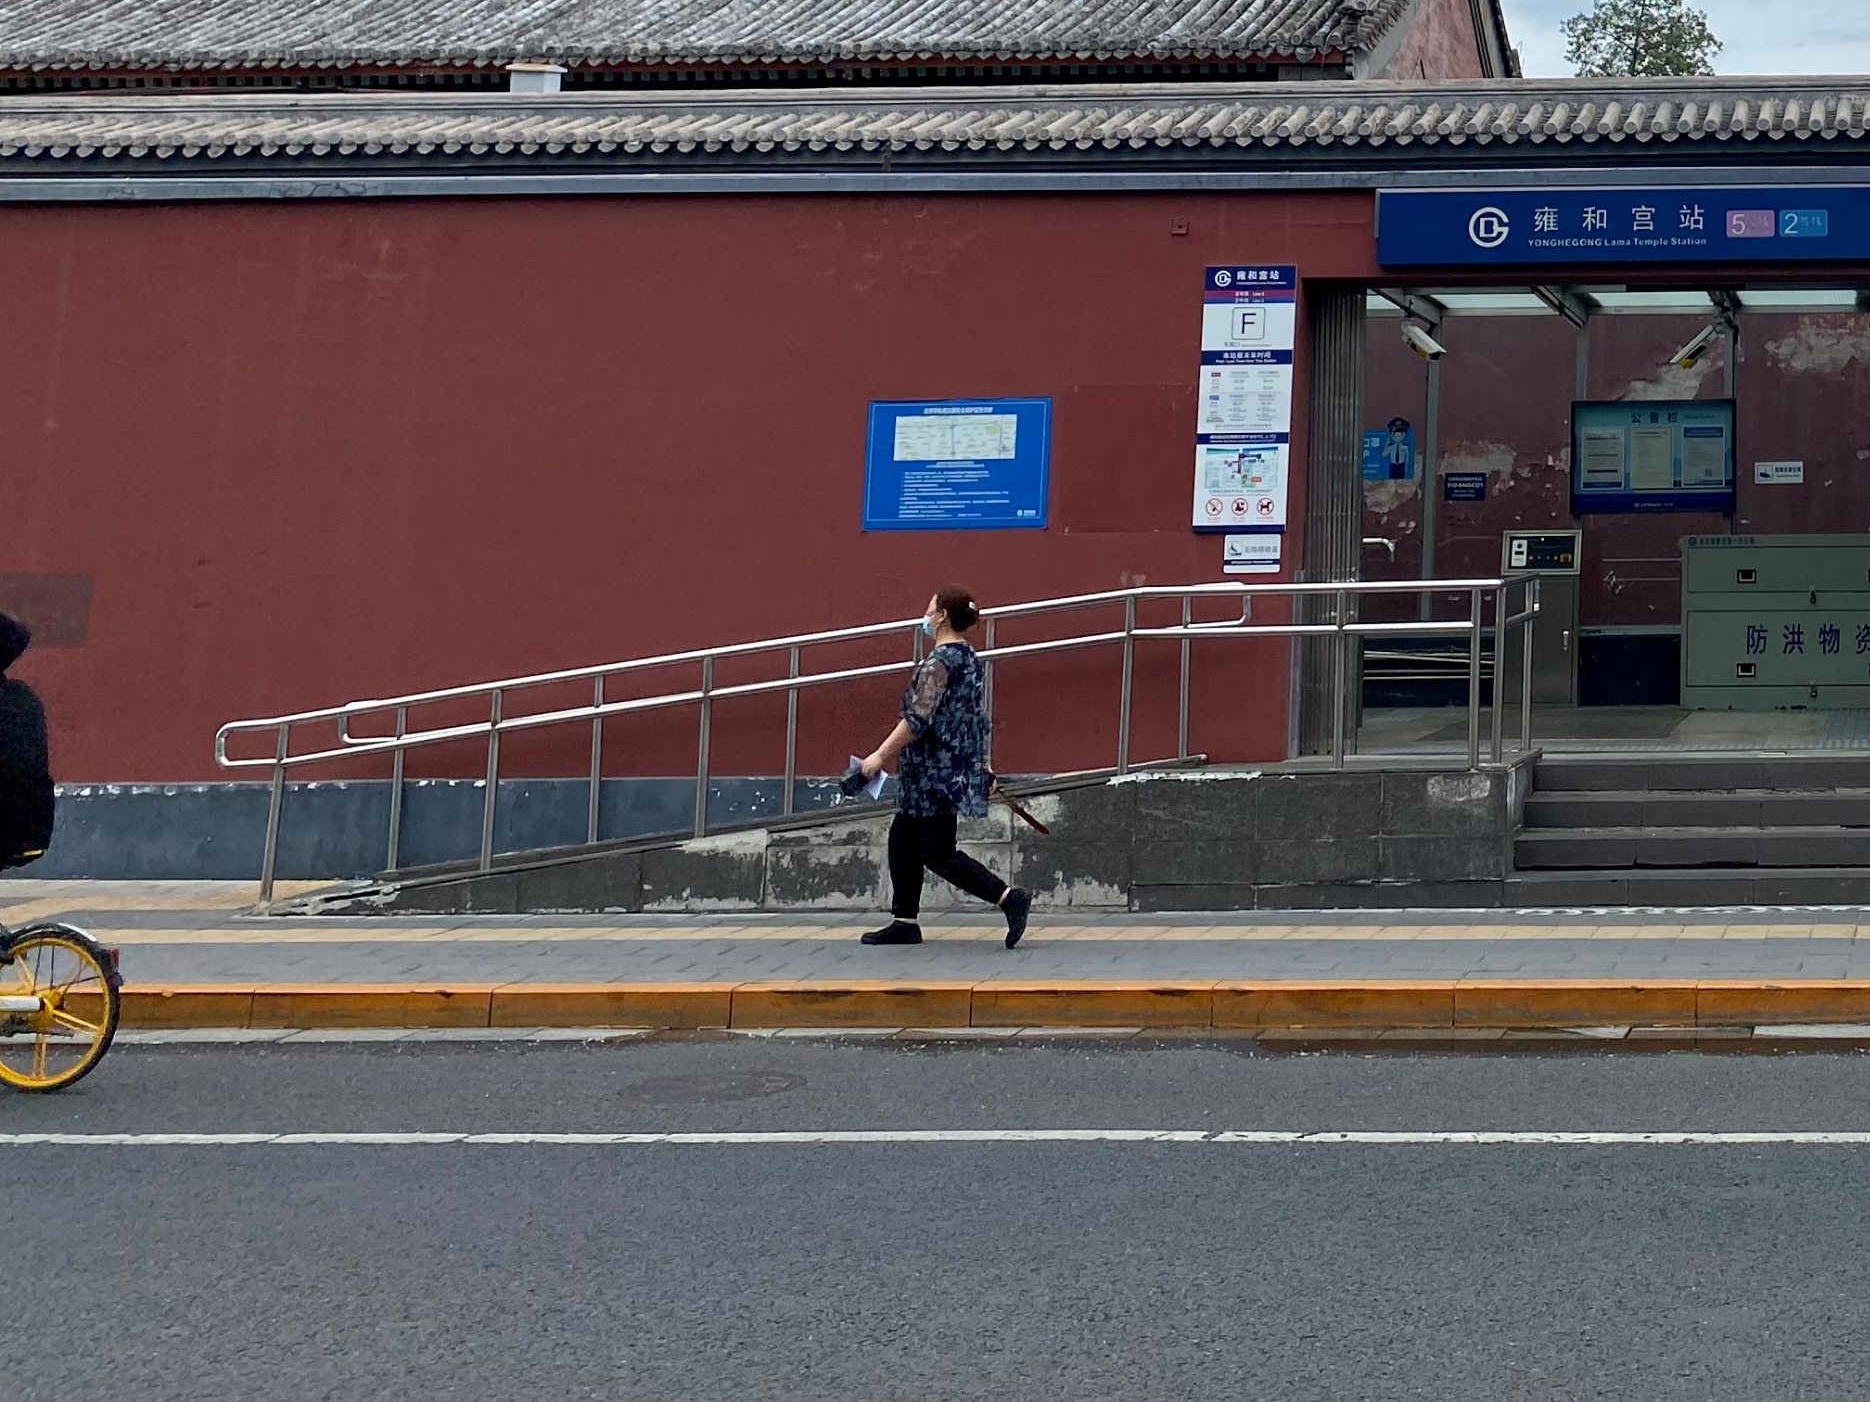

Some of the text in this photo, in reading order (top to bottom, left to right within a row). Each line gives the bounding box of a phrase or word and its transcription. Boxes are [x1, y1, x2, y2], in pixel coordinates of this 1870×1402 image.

[1534, 204, 1705, 233] 雍和宫站
[1528, 236, 1707, 248] YONGHEGONG Lama Temple Station
[1241, 313, 1257, 334] F
